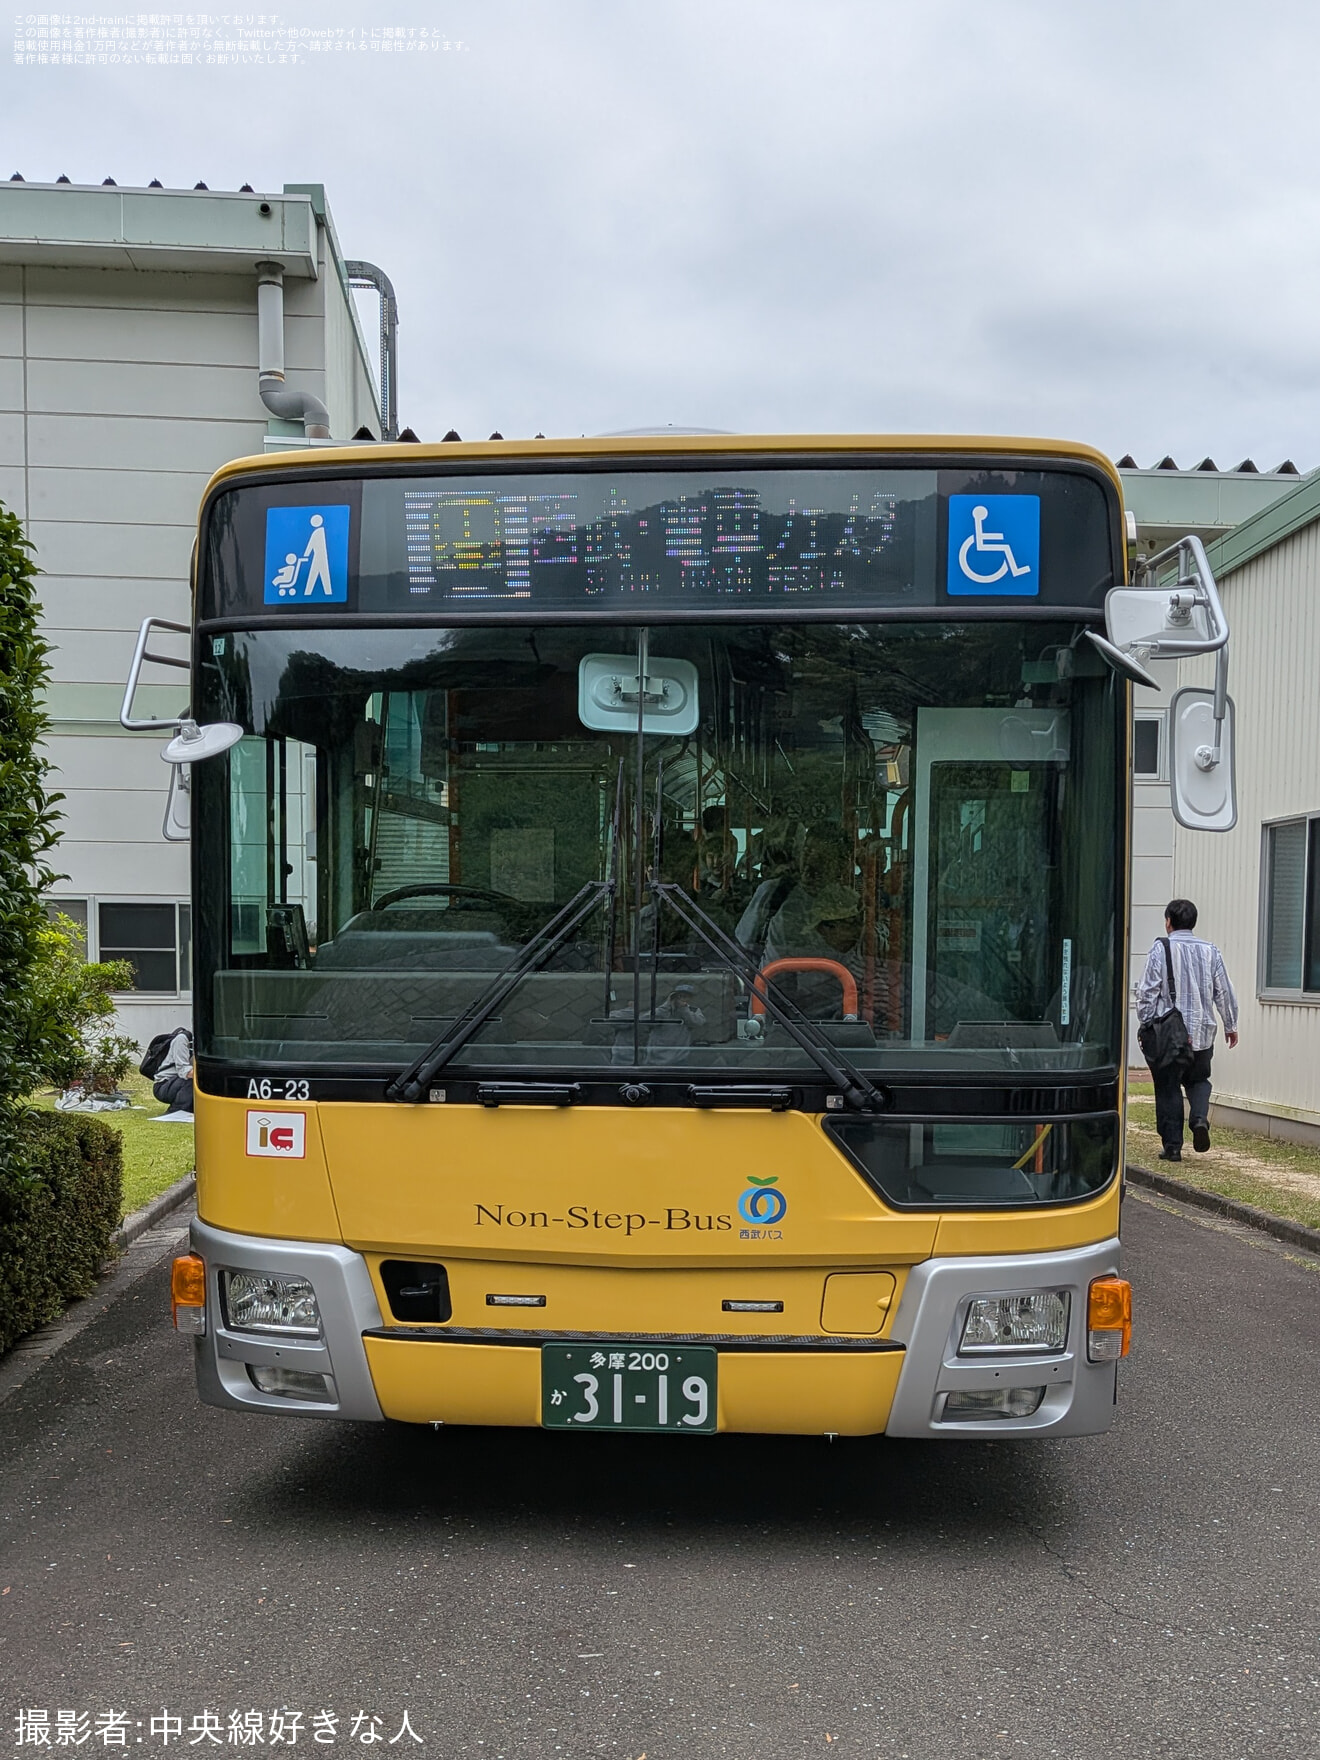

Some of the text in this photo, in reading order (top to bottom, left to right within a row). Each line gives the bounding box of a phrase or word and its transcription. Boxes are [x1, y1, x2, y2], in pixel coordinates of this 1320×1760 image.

[247, 1078, 310, 1100] A6-23
[473, 1203, 732, 1236] Non-Step-Bus
[739, 1229, 783, 1240] 西武バス
[573, 1373, 708, 1426] 31-19
